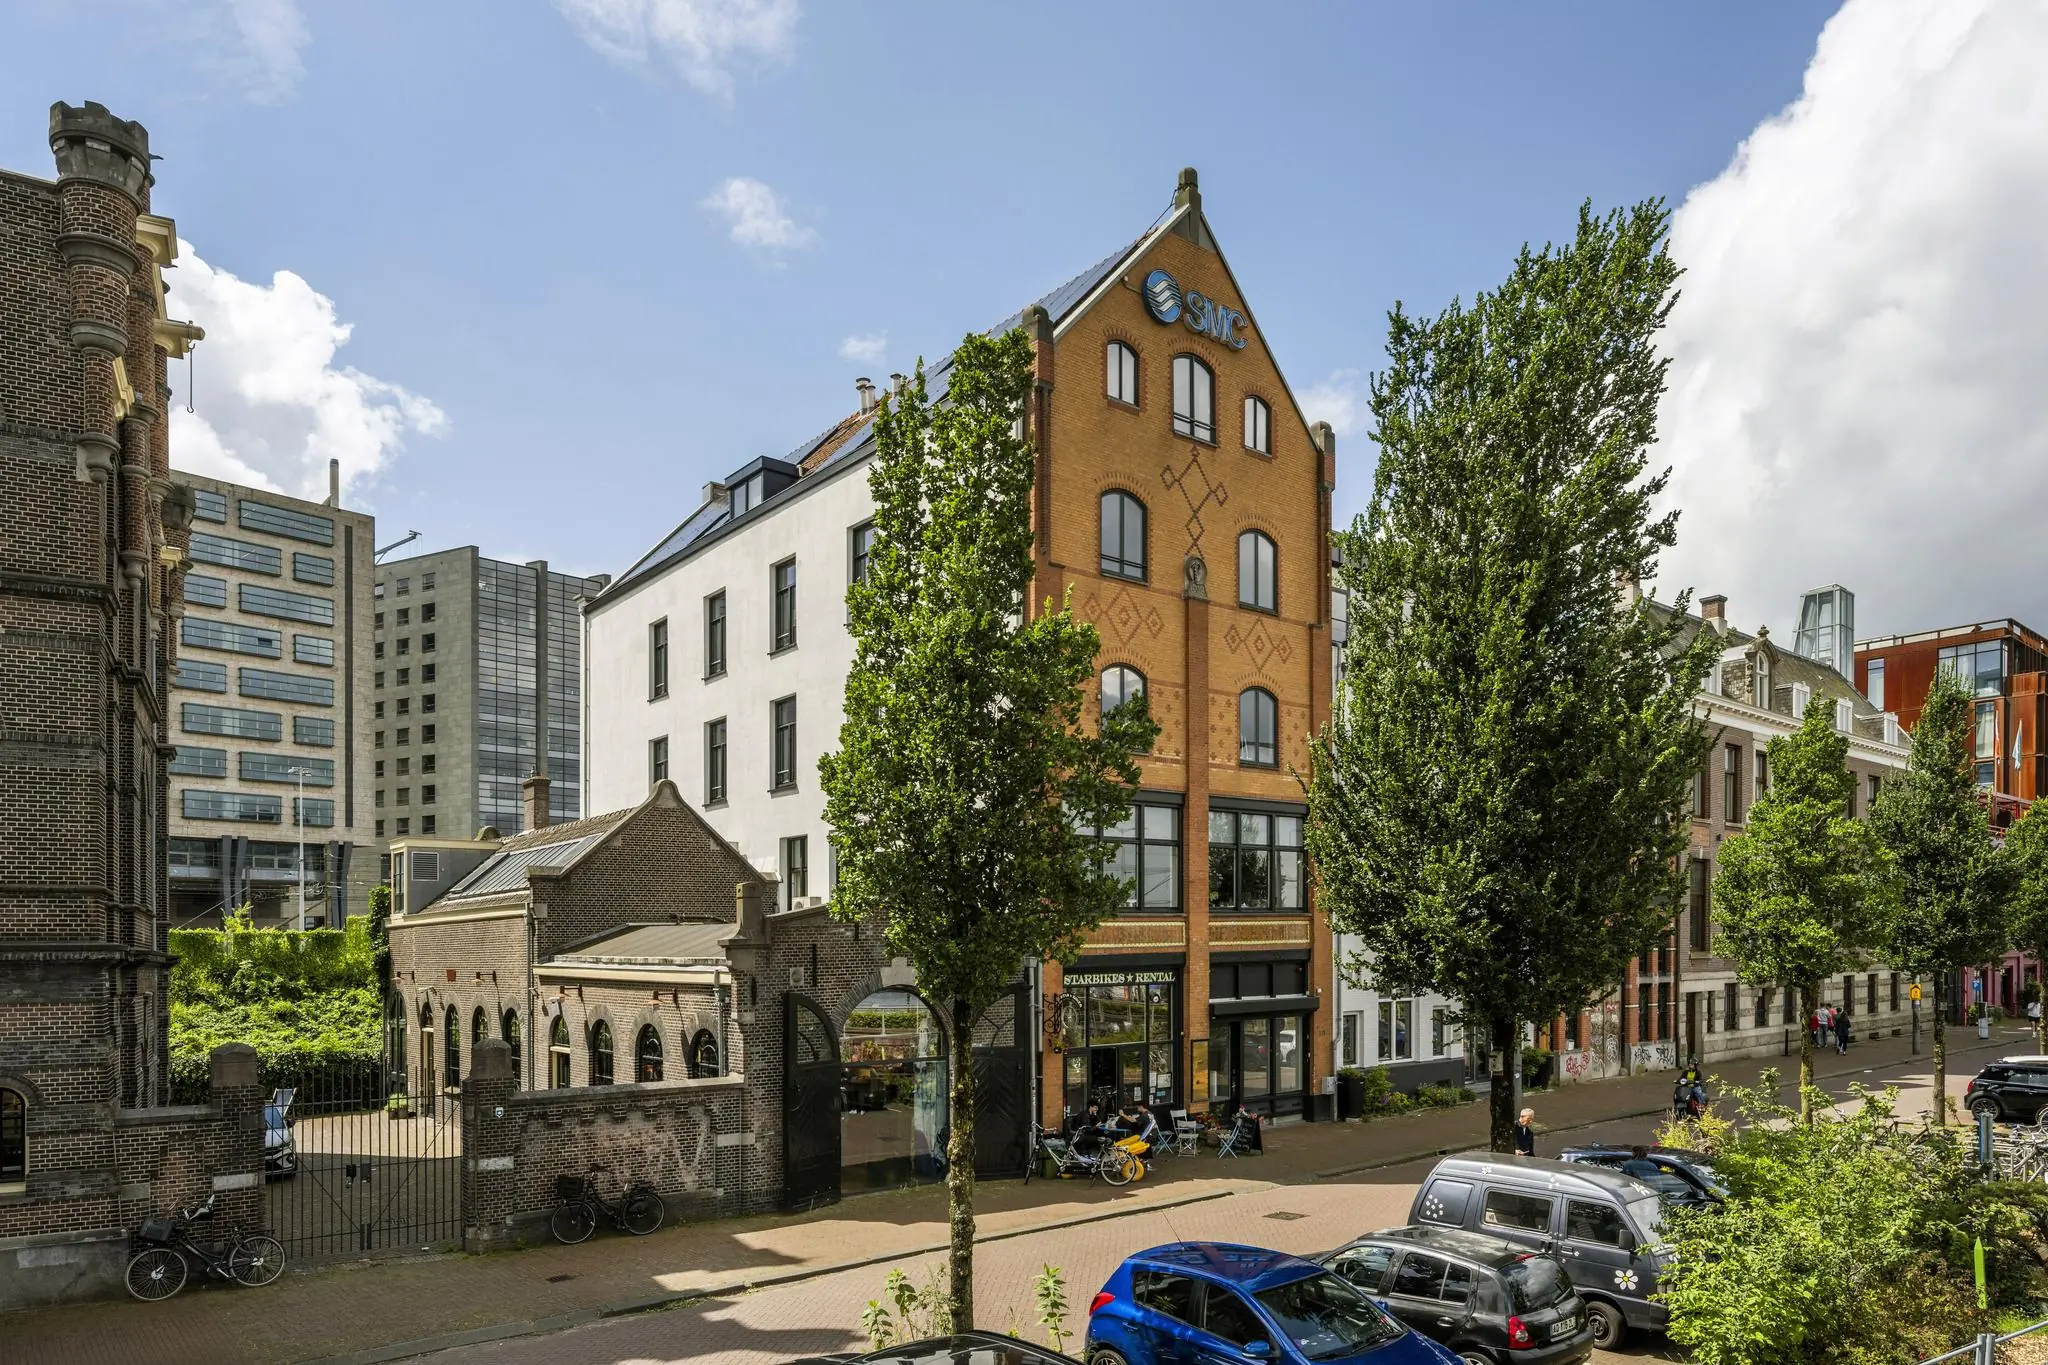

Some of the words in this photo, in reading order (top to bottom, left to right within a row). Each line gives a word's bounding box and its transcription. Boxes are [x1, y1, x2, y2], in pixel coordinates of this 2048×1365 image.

[1183, 290, 1248, 351] SMC
[1064, 974, 1125, 985] STARBIKES
[1135, 971, 1175, 983] RENTAL
